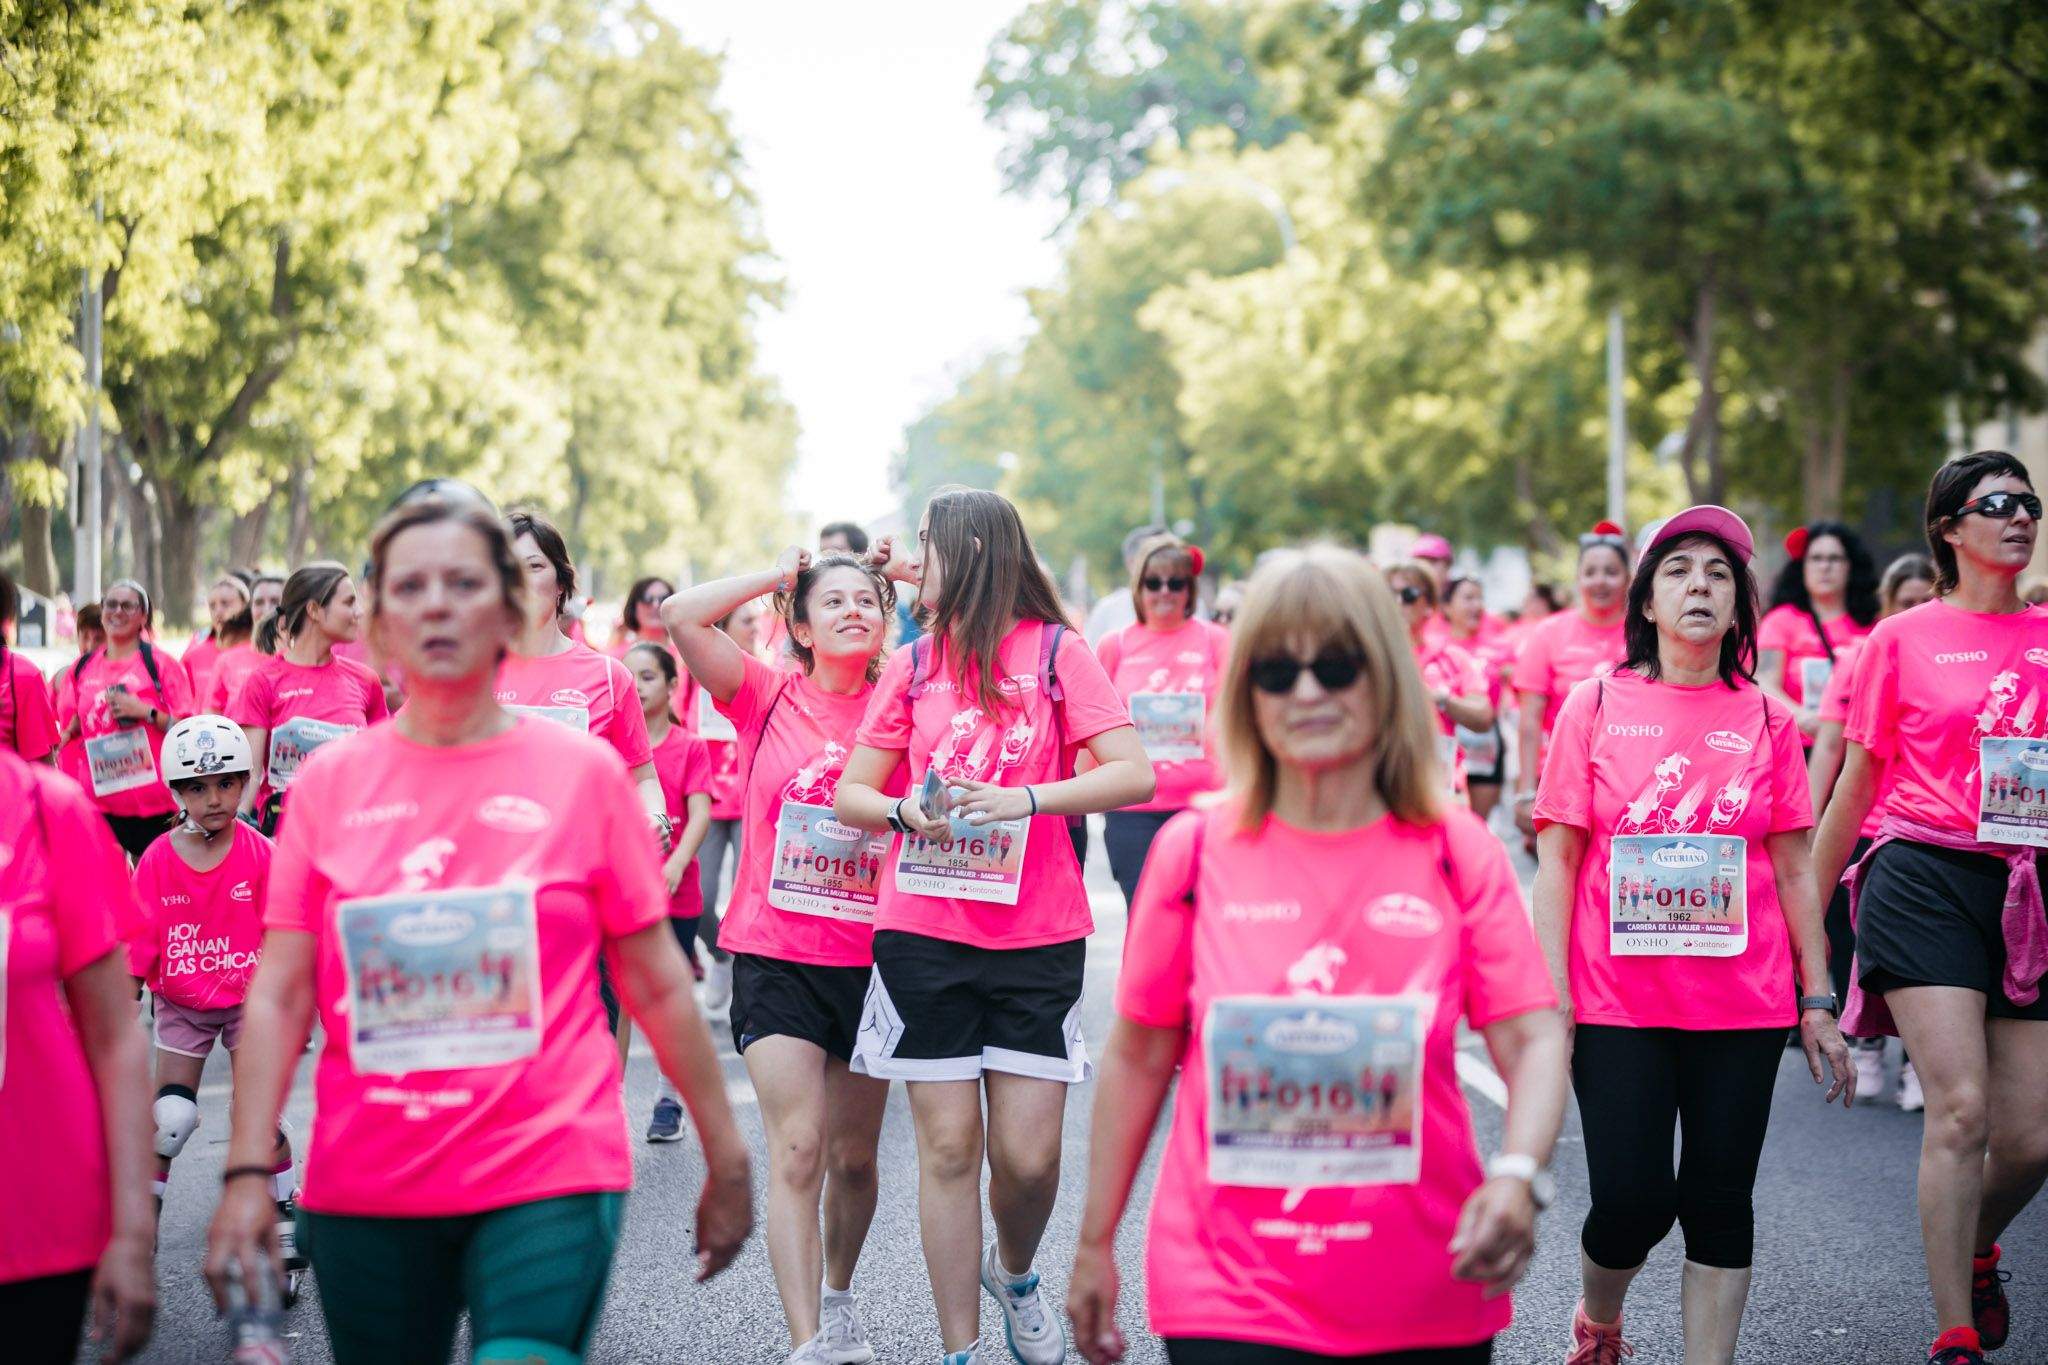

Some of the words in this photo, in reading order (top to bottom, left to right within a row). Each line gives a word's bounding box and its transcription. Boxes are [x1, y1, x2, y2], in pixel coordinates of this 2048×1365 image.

[1935, 651, 1988, 664] OYSHO
[1607, 724, 1663, 737] OYSHO
[820, 822, 860, 838] ASTURIANA
[1992, 828, 2030, 840] OYSHO
[940, 837, 984, 856] 016
[948, 859, 969, 868] 1854
[1656, 851, 1705, 863] ASTURIANA
[815, 856, 856, 877] 016
[911, 865, 937, 874] CARRERA
[956, 870, 976, 879] MUJER
[981, 872, 1005, 881] MADRID
[823, 878, 842, 888] 1855
[908, 878, 945, 889] OYSHO
[968, 886, 1003, 895] Santander
[785, 882, 811, 892] CARRERA
[812, 886, 820, 894] DE
[821, 887, 829, 895] LA
[830, 889, 849, 898] MUJER
[853, 893, 875, 902] MADRID
[1656, 887, 1707, 907] 016
[781, 895, 819, 907] OYSHO
[841, 905, 875, 917] Santander
[1668, 912, 1691, 921] 1962
[168, 923, 201, 942] HOY
[1627, 923, 1657, 931] CARRERA
[1658, 923, 1667, 931] DE
[1668, 923, 1677, 931] LA
[1678, 924, 1700, 932] MUJER
[1706, 924, 1730, 933] MADRID
[167, 936, 229, 959] GANAN
[1627, 937, 1668, 947] OYSHO
[1694, 940, 1731, 949] Santander
[166, 958, 197, 977] LAS
